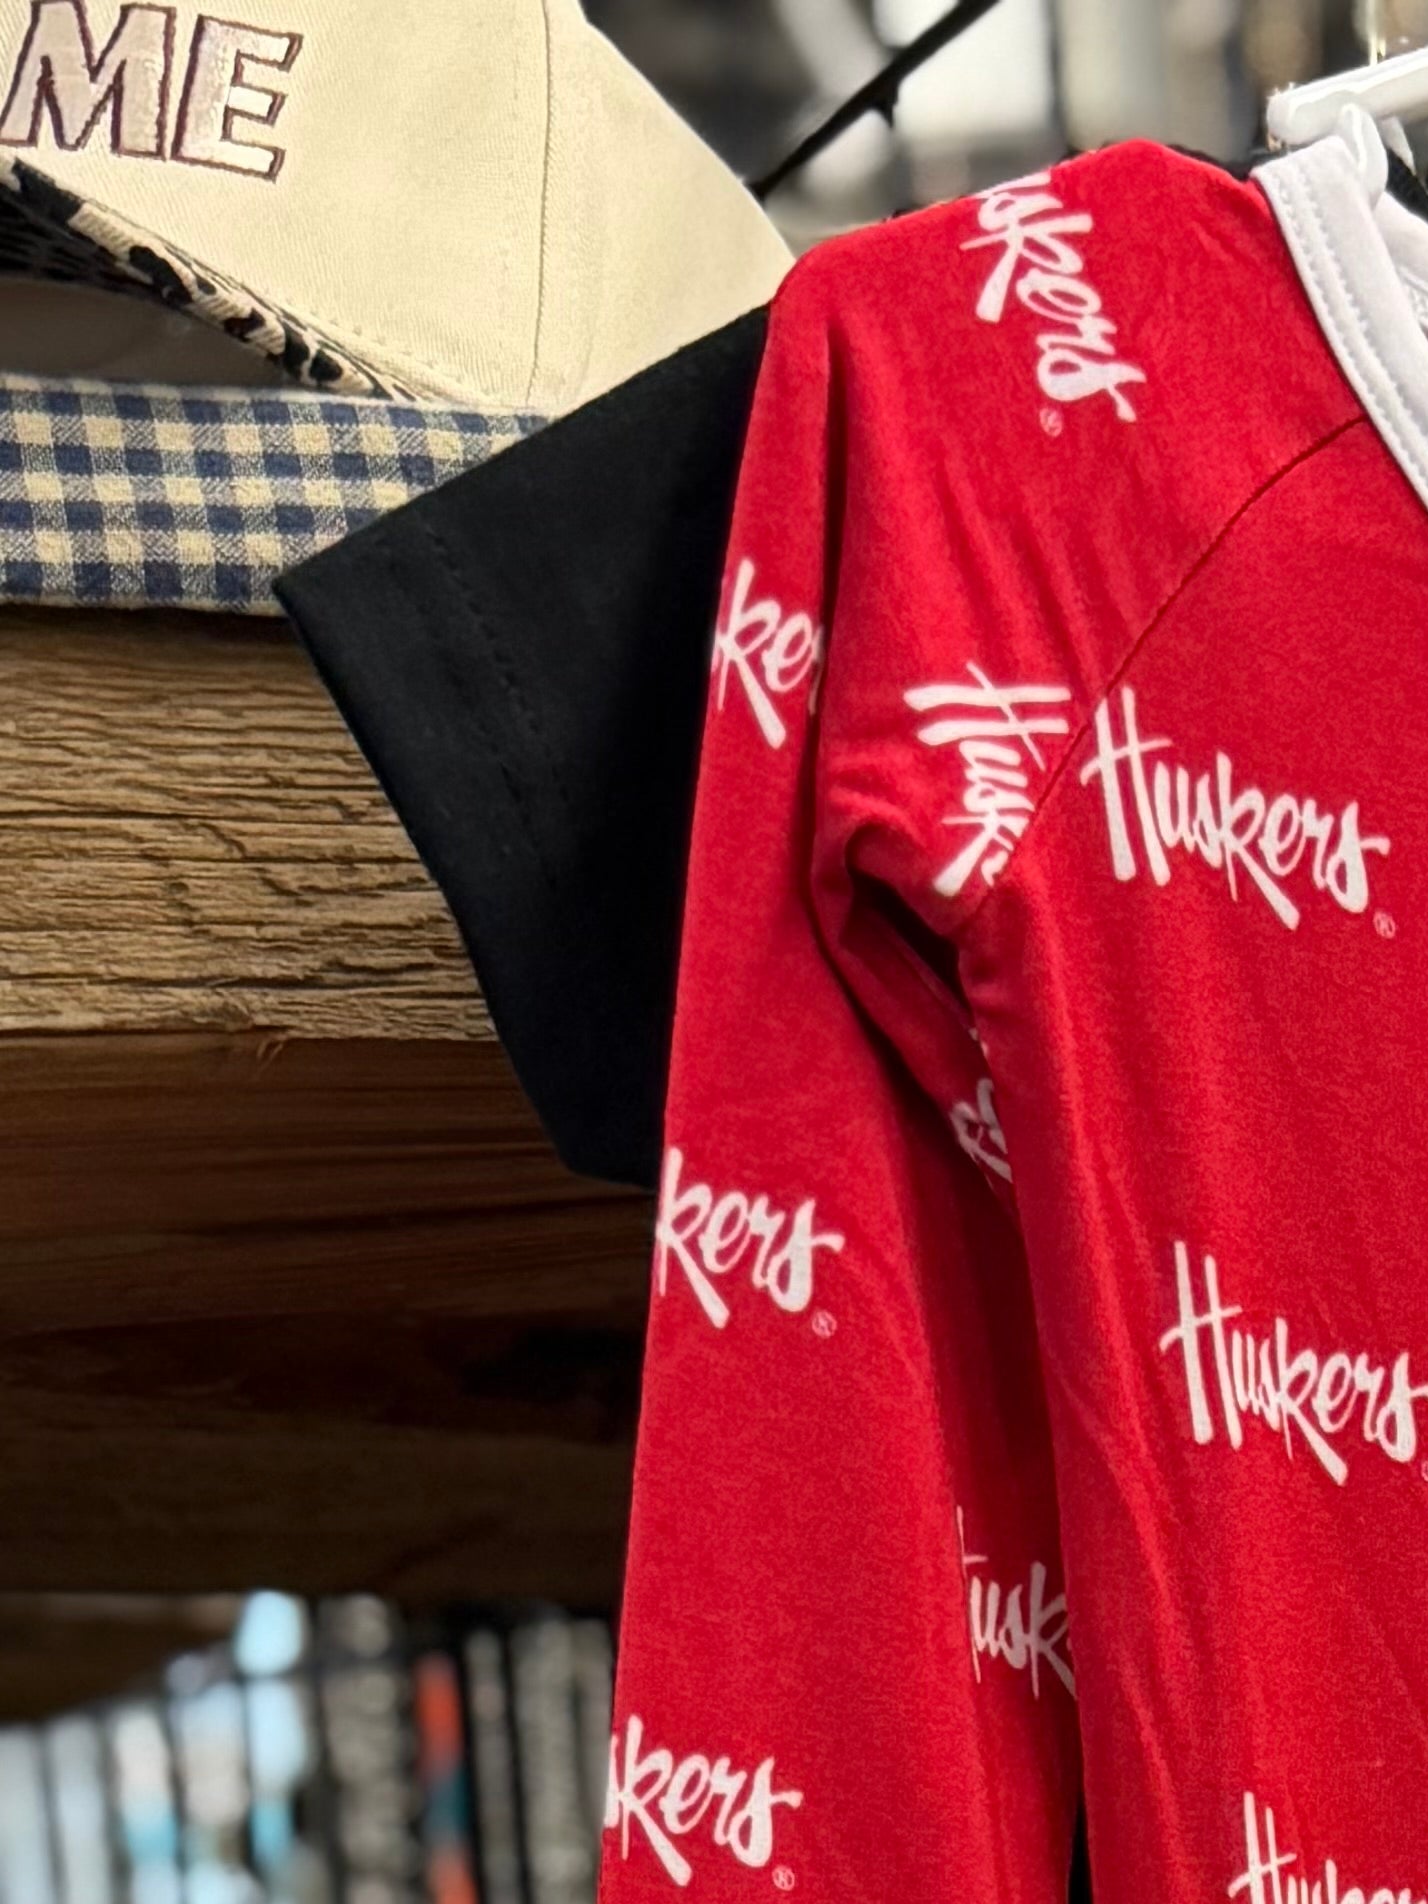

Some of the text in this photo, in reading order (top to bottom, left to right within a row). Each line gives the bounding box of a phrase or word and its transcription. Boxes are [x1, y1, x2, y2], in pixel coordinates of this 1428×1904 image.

[0, 0, 303, 183] ME
[1079, 685, 1391, 930] Huskers
[654, 1147, 845, 1330] kers
